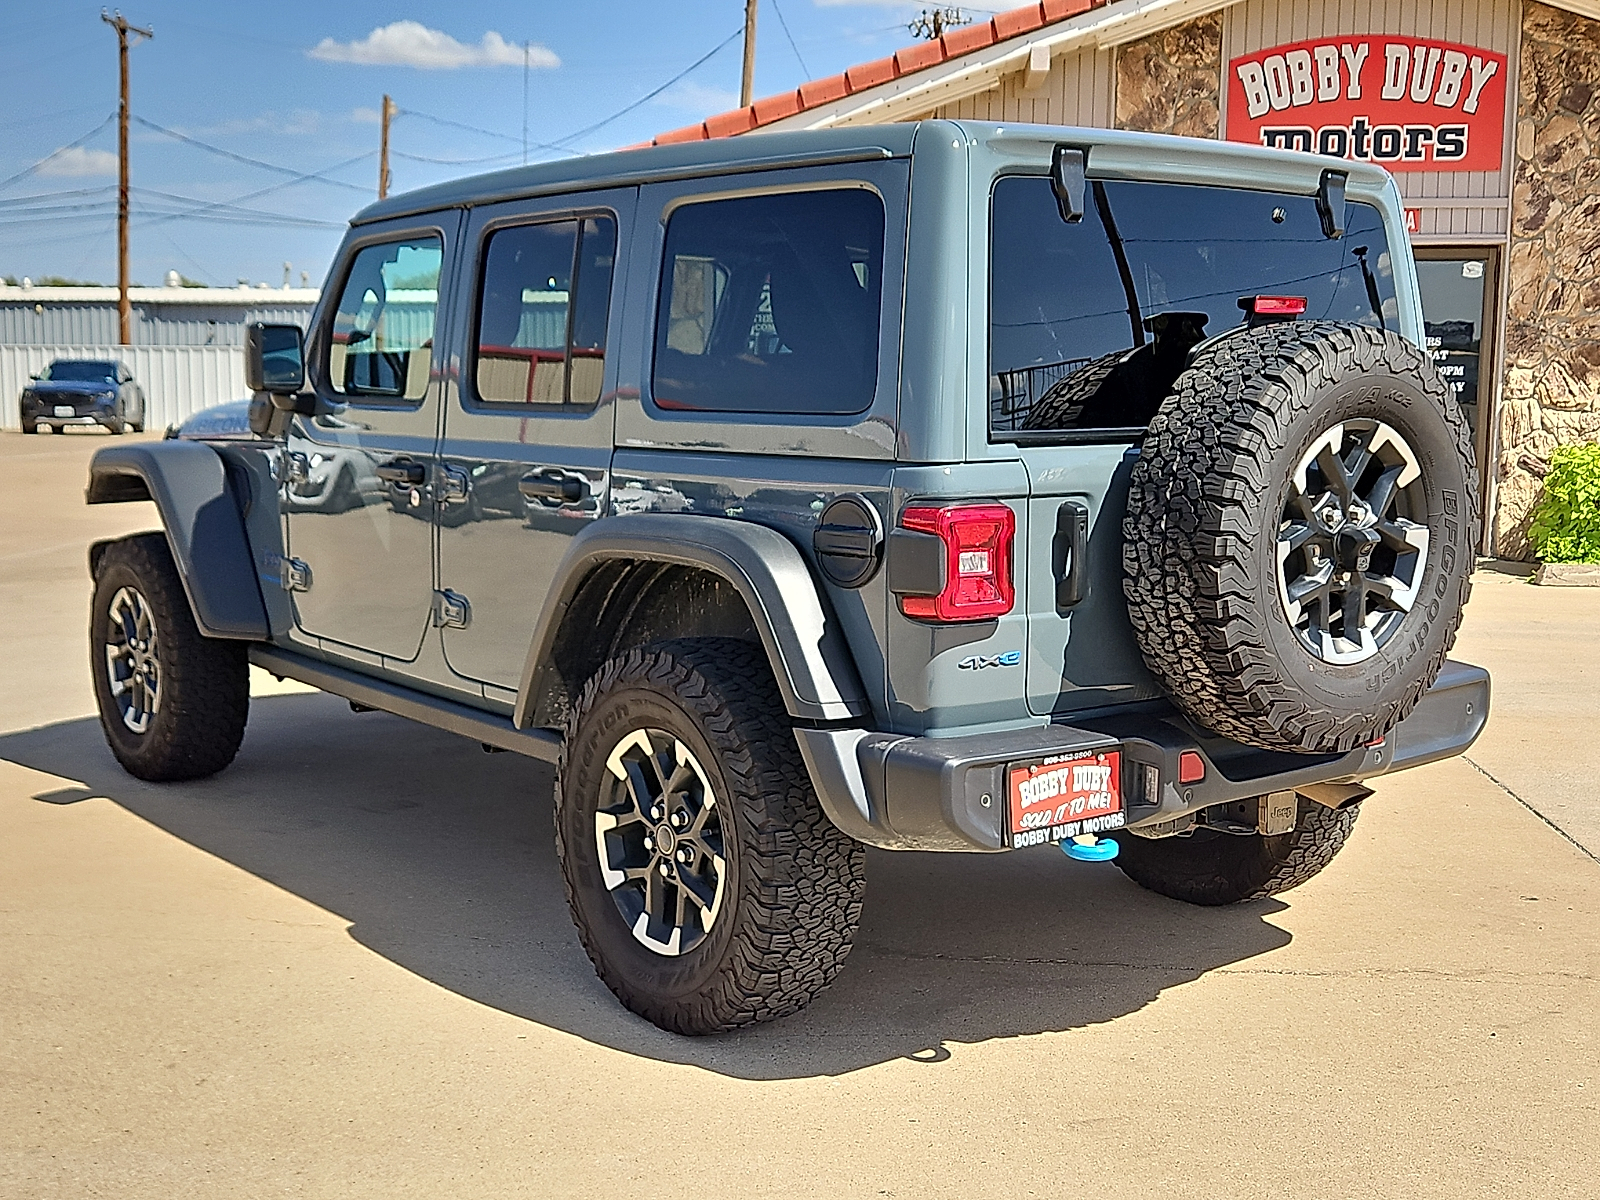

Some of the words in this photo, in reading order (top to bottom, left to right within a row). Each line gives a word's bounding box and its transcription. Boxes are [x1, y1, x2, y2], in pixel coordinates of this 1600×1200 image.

[1236, 42, 1369, 119] BOBBY
[1381, 43, 1499, 115] DUBY
[1260, 115, 1469, 162] motors
[1425, 336, 1442, 347] RS
[1450, 381, 1466, 392] AY
[1018, 767, 1069, 809] BOBBY
[1072, 765, 1111, 792] DUBY
[1019, 809, 1052, 828] SOLD
[1053, 802, 1069, 822] IT
[1069, 796, 1086, 816] TO
[1087, 791, 1112, 810] ME!
[1270, 806, 1293, 819] Jeep
[1013, 828, 1051, 848] BOBBY
[1052, 820, 1082, 841] DUBY
[1082, 812, 1125, 834] MOTORS
